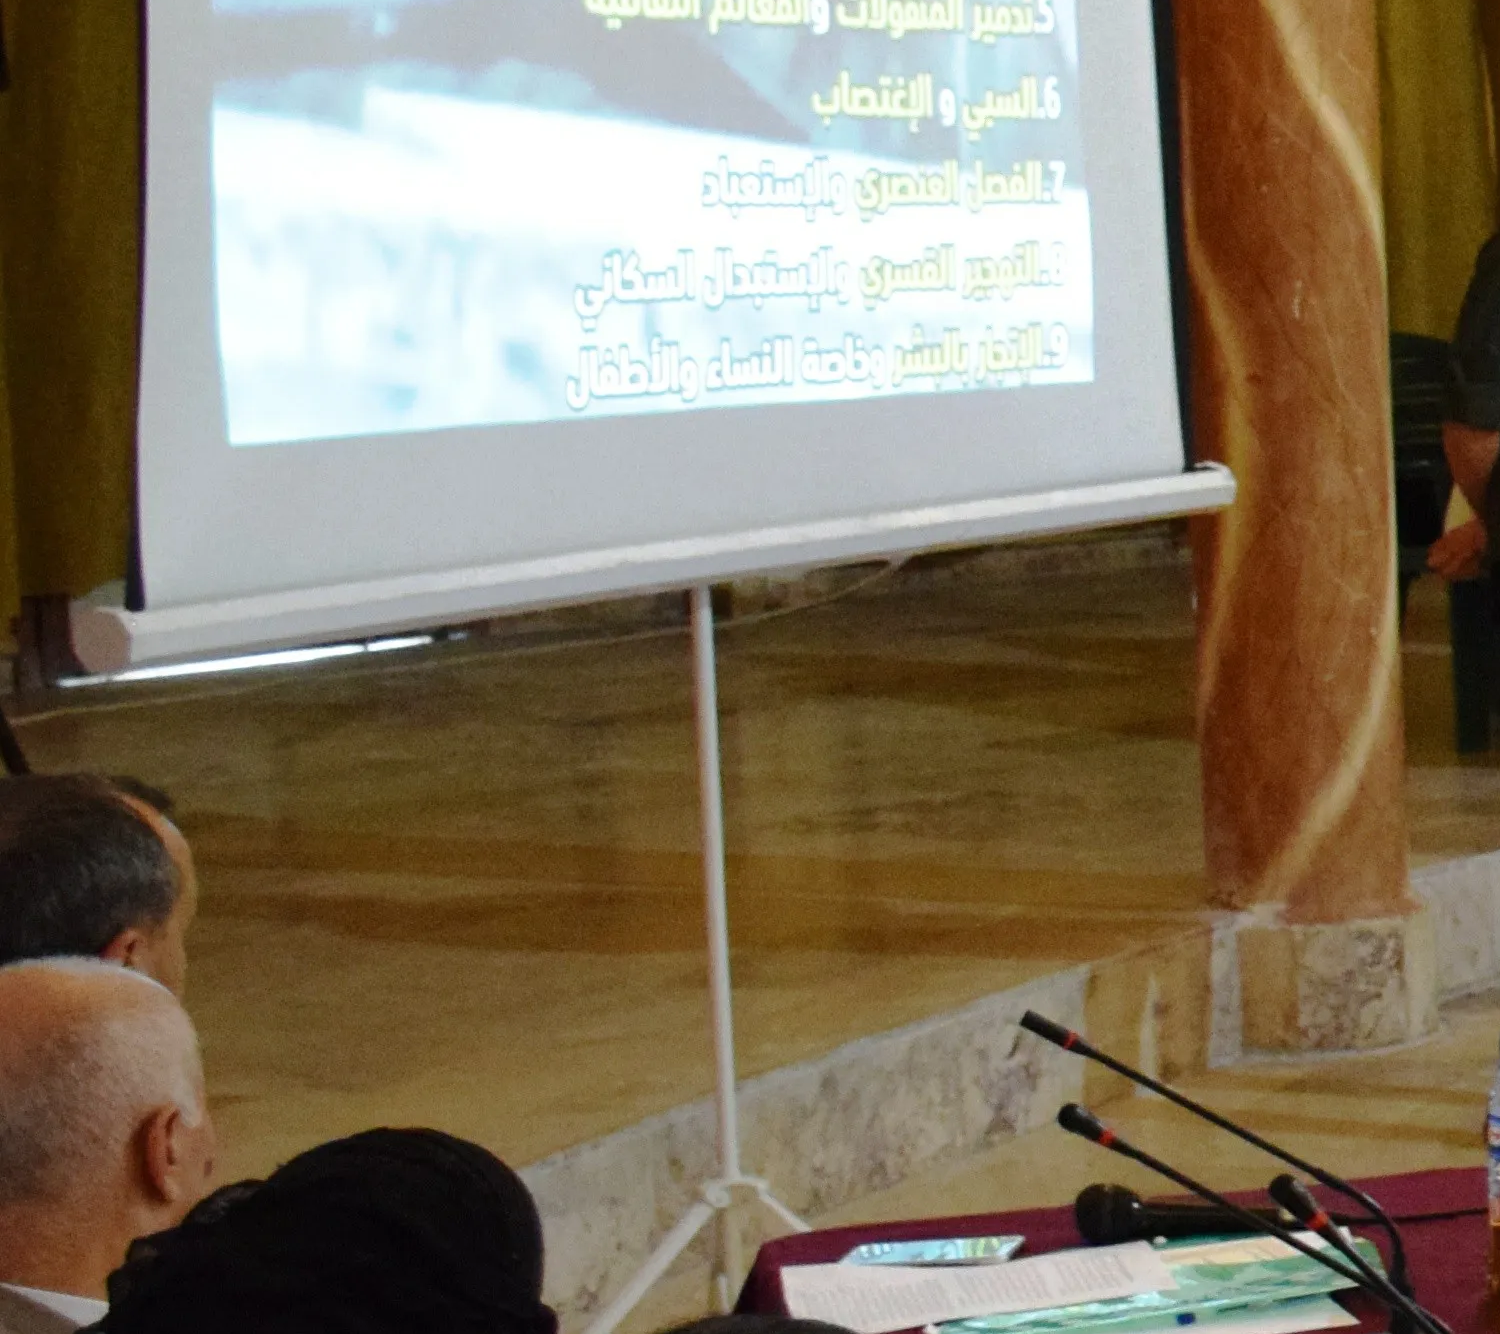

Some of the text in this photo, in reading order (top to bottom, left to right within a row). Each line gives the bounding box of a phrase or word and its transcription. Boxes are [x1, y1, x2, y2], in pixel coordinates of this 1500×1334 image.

[939, 87, 957, 127] و
[854, 159, 960, 221] العنصري
[574, 248, 695, 331] السكاني
[859, 243, 956, 310] القسري
[566, 334, 699, 410] والأطفال
[705, 334, 793, 390] النساء
[800, 332, 886, 387] وخاصة
[893, 323, 969, 388] بالبشر
